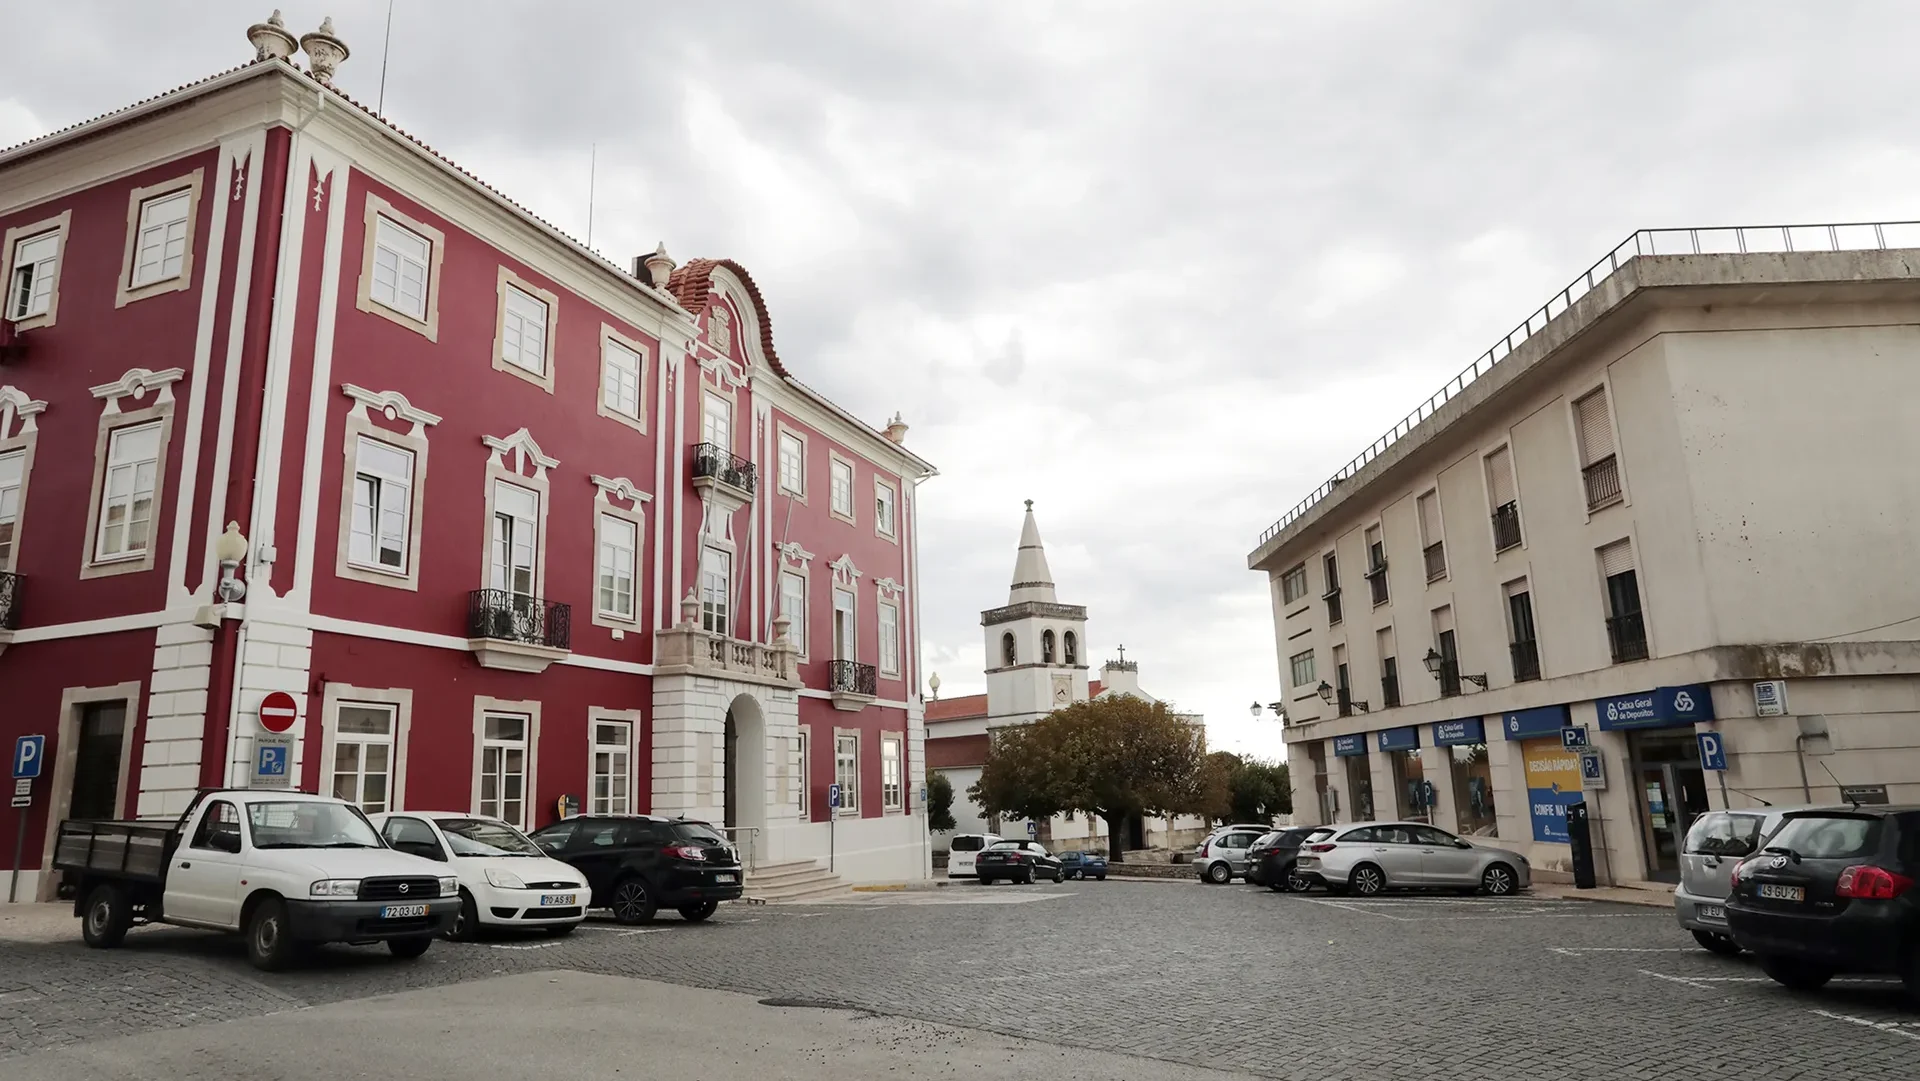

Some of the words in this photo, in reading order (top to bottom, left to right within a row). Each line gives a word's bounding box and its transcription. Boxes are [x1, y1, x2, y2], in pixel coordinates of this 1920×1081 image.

[1617, 701, 1635, 711] Caixa
[1634, 698, 1652, 709] Geral
[1619, 712, 1626, 720] de
[1565, 730, 1576, 745] P
[19, 740, 36, 773] P
[262, 749, 276, 768] P
[1702, 736, 1718, 767] P
[1585, 758, 1593, 773] P
[831, 786, 838, 805] P
[1534, 803, 1554, 816] CONFIE
[1579, 808, 1585, 817] P
